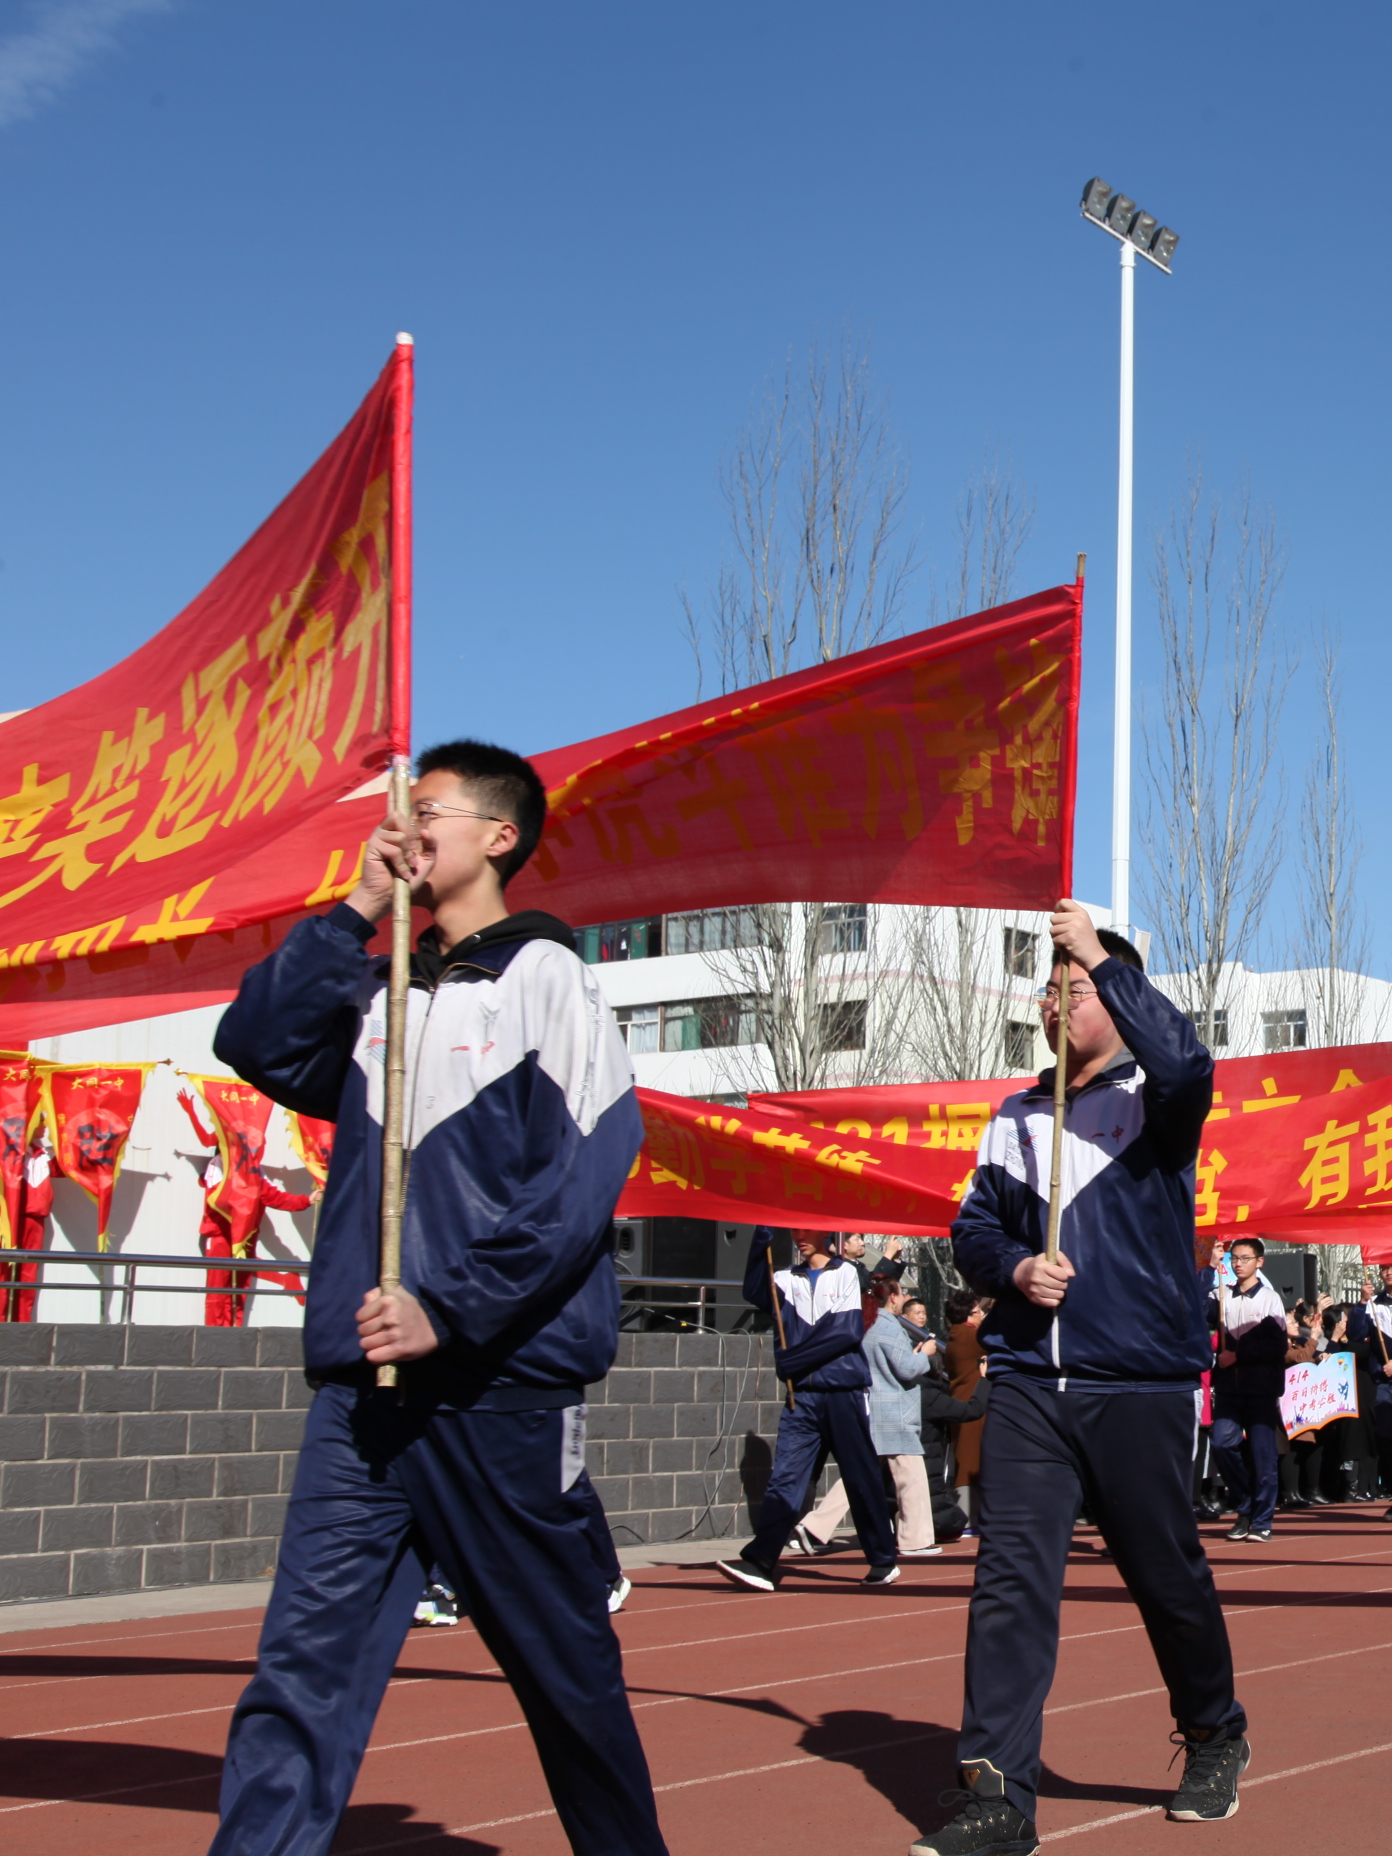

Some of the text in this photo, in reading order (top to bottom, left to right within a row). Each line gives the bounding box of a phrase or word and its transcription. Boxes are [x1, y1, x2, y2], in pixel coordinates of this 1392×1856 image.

[71, 1076, 124, 1090] 大同一中
[221, 1089, 260, 1106] 大同一中
[1091, 1125, 1124, 1144] 一中
[1288, 1369, 1309, 1385] 414
